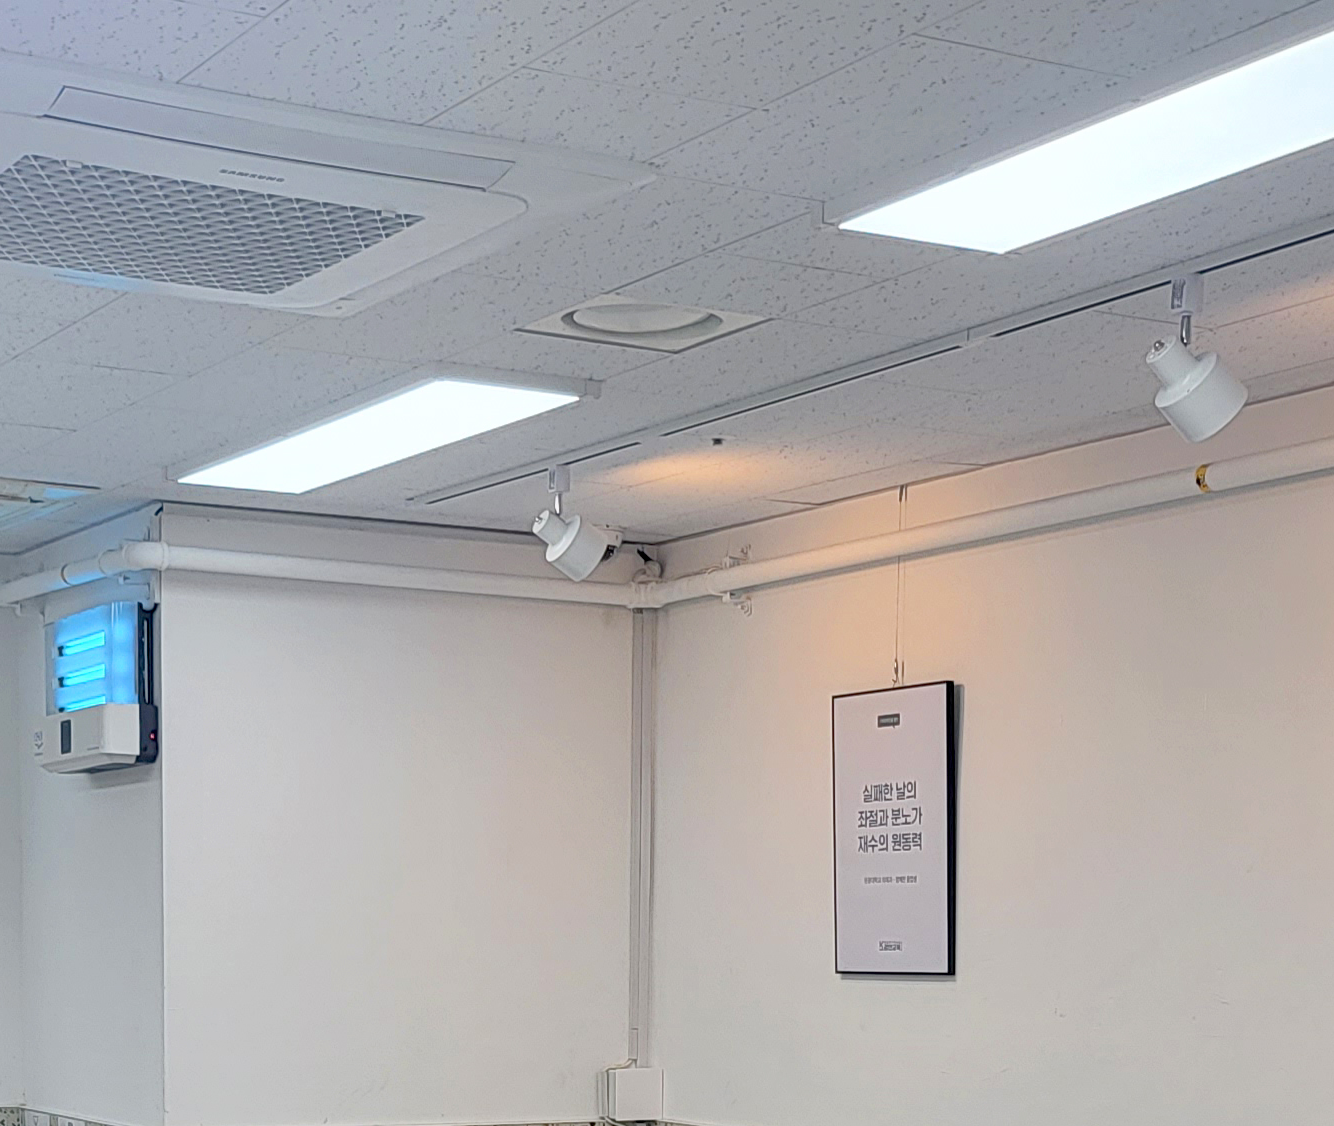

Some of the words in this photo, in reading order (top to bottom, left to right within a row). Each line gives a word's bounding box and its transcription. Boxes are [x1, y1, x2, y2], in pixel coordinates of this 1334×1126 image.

[219, 168, 285, 183] SAMSUNG
[863, 783, 894, 803] 실패한
[896, 780, 917, 801] 날의
[857, 808, 889, 829] 좌절과
[891, 805, 923, 826] 분노가
[857, 833, 889, 854] 재수의
[891, 831, 923, 852] 원동력
